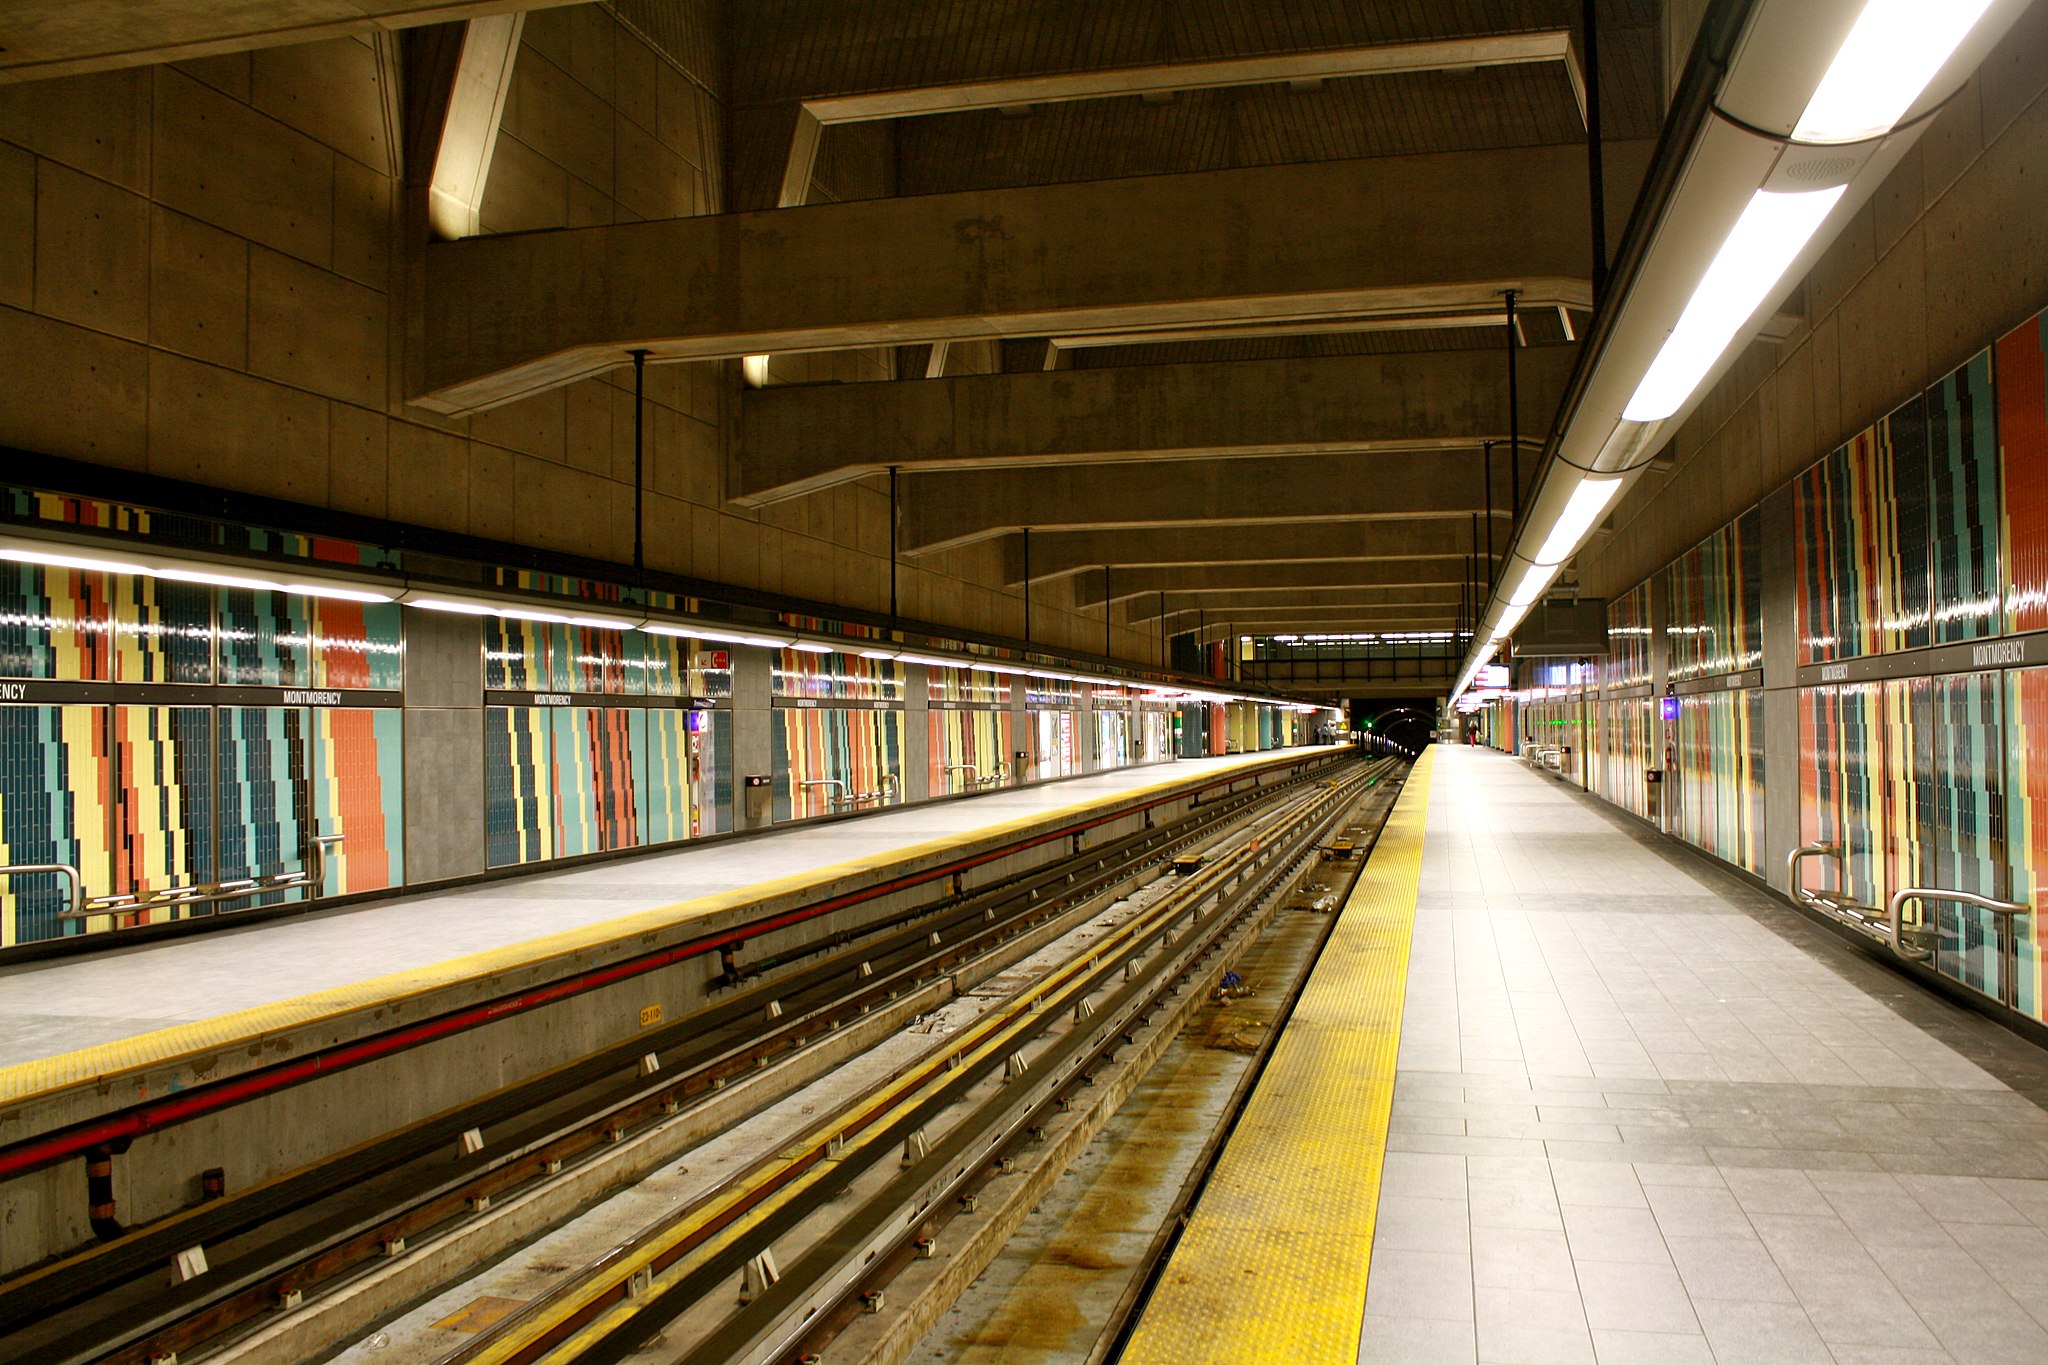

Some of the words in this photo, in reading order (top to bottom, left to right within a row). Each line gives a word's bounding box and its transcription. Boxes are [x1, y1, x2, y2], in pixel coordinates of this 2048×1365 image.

[1973, 640, 2025, 666] MONTMORENCY
[0, 684, 26, 700] NCY
[283, 691, 341, 704] MONTMORENCY
